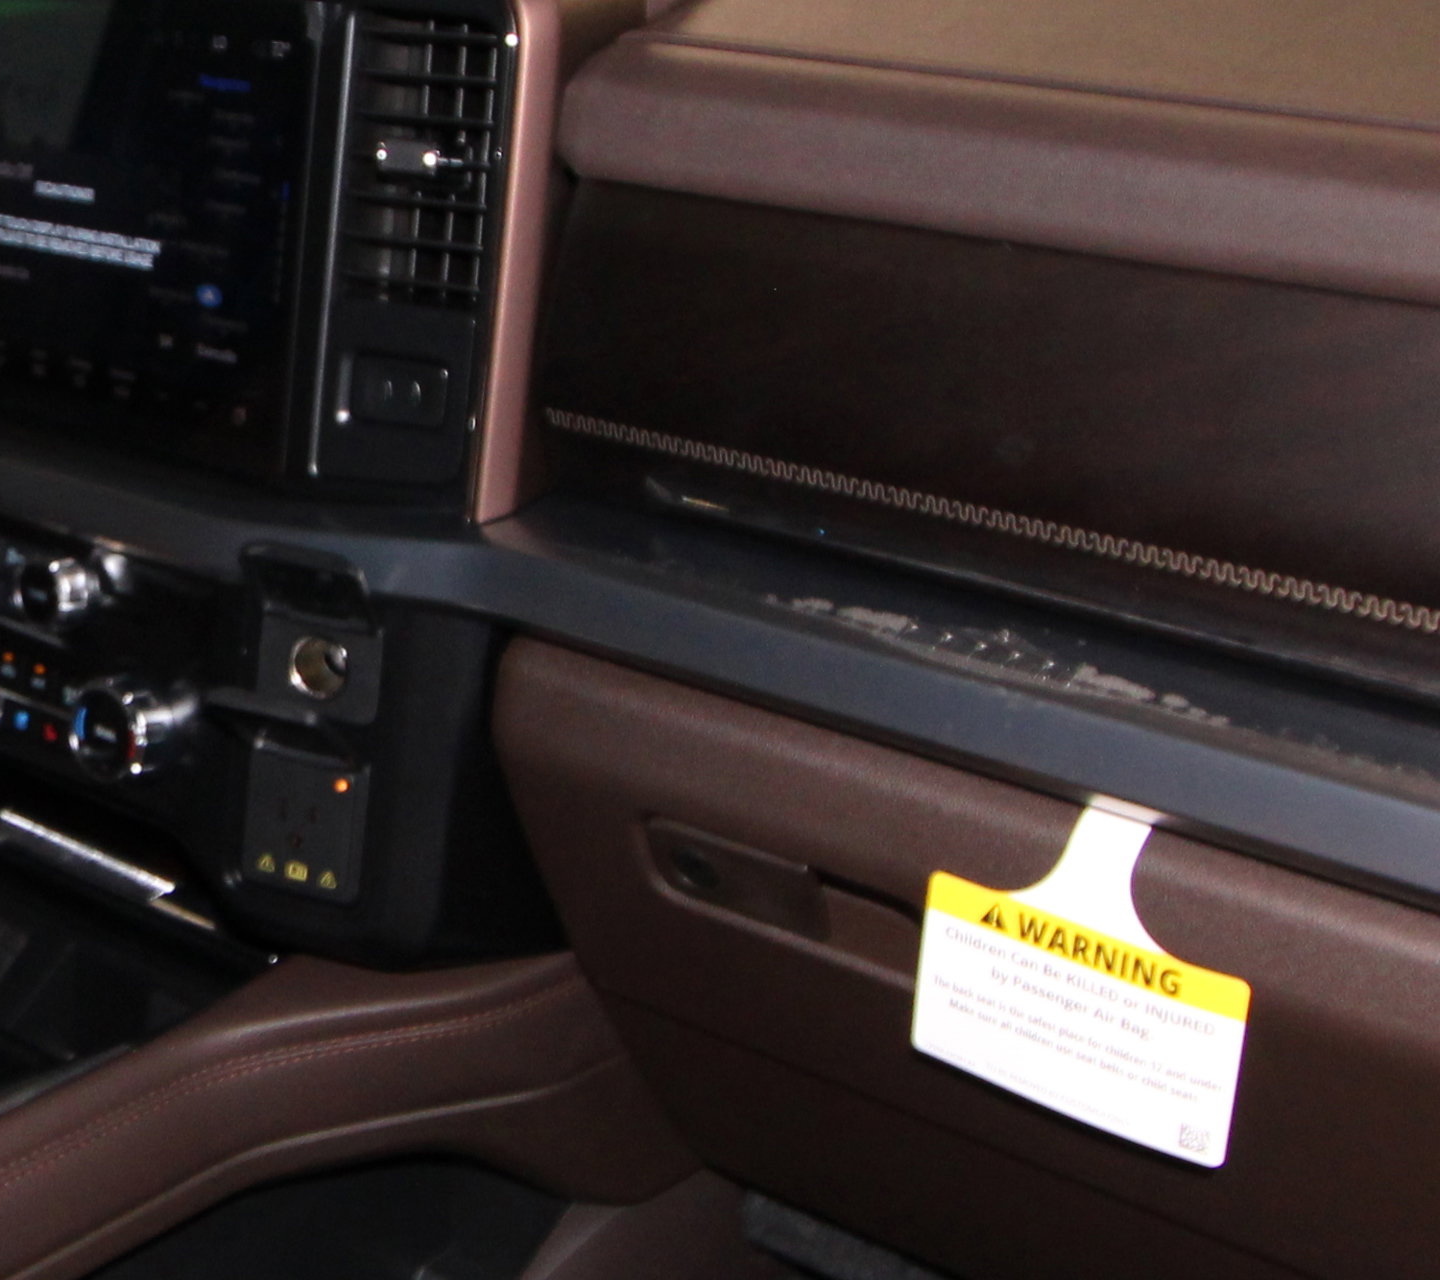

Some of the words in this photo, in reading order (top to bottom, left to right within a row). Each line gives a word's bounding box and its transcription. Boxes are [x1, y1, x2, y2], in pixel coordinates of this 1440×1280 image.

[945, 925, 1007, 960] Children
[1010, 951, 1039, 972] Can
[1042, 963, 1062, 979] Be
[1065, 972, 1120, 1003] KILLED
[1123, 996, 1140, 1009] or
[1145, 1003, 1216, 1036] INJURED
[990, 965, 1009, 986] by
[1013, 975, 1090, 1015] Passenger
[1093, 1007, 1117, 1023] Air
[1018, 911, 1183, 998] WARNING
[933, 974, 951, 989] The
[952, 980, 974, 1000] back
[1027, 1012, 1057, 1033] safest
[1058, 1026, 1085, 1044] place
[1104, 1043, 1148, 1068] children
[1165, 1066, 1186, 1081] and
[948, 997, 975, 1017] Make
[1014, 1024, 1054, 1048] children
[1055, 1042, 1074, 1056] use
[1076, 1050, 1097, 1067] seat
[1141, 1075, 1169, 1093] child
